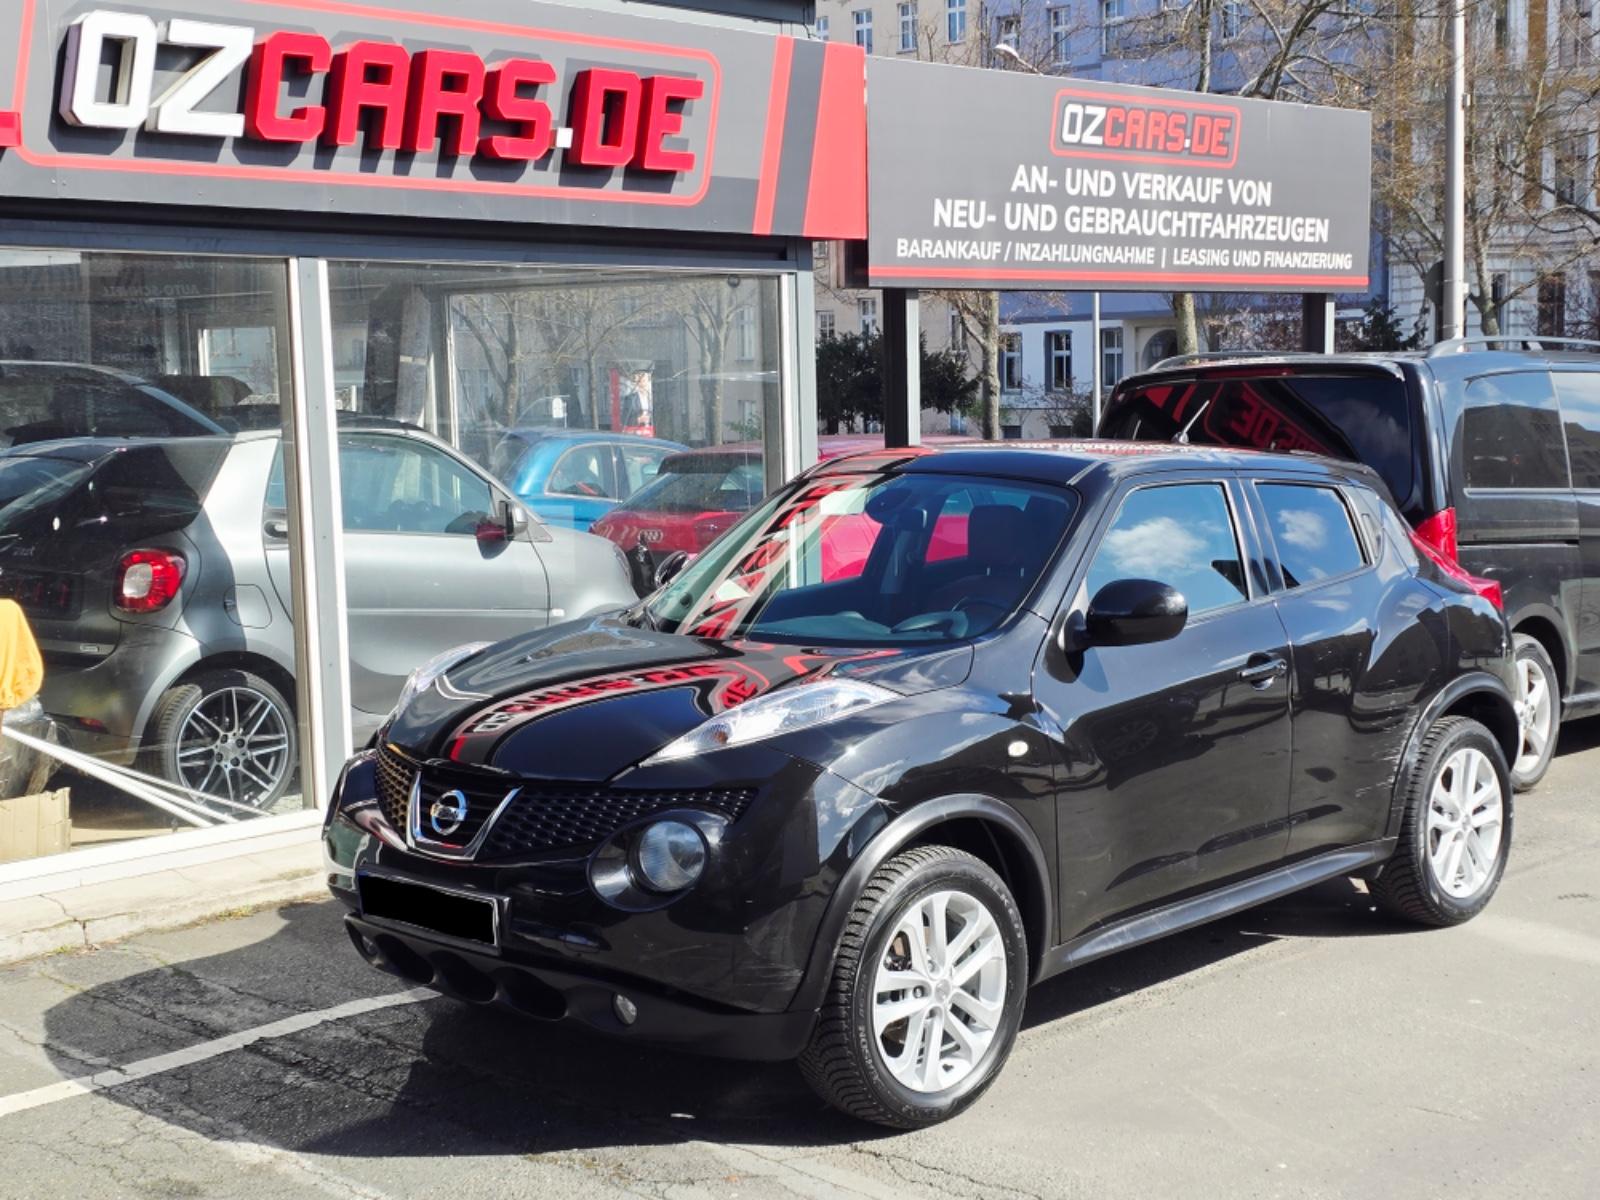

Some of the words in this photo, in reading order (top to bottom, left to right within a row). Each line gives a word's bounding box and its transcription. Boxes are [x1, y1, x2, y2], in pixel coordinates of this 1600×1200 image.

[62, 11, 704, 173] OZCARS.DE
[1061, 103, 1231, 156] OZCARS.DE
[1010, 163, 1058, 194] AN-
[1065, 168, 1116, 198] UND
[1122, 171, 1223, 205] VERKAUF
[1227, 178, 1273, 207] VON
[933, 198, 997, 230] NEU-
[1004, 202, 1057, 232] UND
[1064, 205, 1330, 243] GEBRAUCHTFAHRZEUGEN
[896, 238, 1002, 260] BARANKAUF
[1015, 243, 1156, 265] INZAHLUNGNAHME
[1173, 248, 1230, 267] LEASING
[1232, 250, 1261, 267] UND
[1263, 251, 1353, 270] FINANZIERUNG
